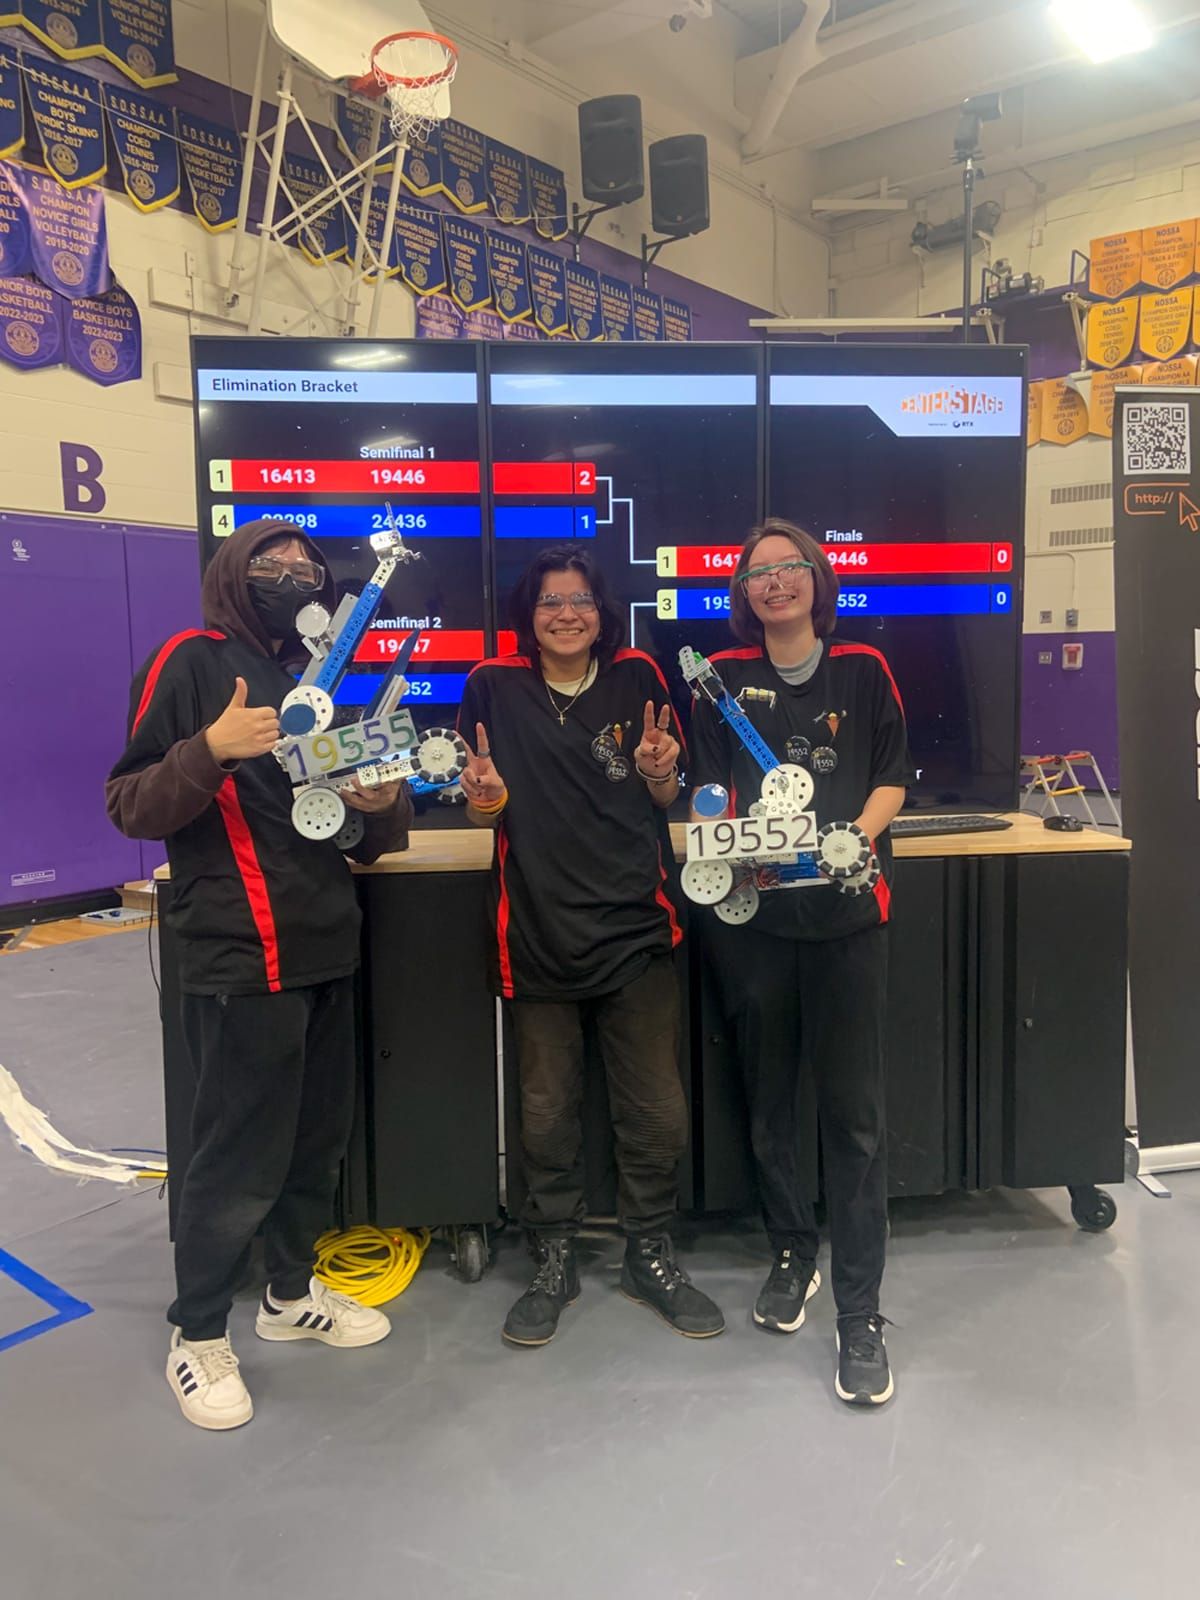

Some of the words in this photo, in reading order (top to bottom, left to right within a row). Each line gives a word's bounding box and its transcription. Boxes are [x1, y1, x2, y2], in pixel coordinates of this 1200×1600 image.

[38, 90, 86, 115] CHAMPION
[50, 106, 76, 123] BOYS
[67, 123, 99, 139] SKIING
[117, 118, 160, 141] CHAMPION
[127, 133, 151, 149] COED
[126, 142, 155, 161] TENNIS
[40, 194, 90, 218] CHAMPION
[32, 205, 69, 225] NOVICE
[71, 216, 99, 233] GIRLS
[35, 219, 98, 246] VOLLEYBALL
[26, 285, 52, 301] BOYS
[1154, 296, 1178, 307] NOSSA
[73, 308, 133, 331] BASKETBALL
[106, 304, 133, 319] BOYS
[212, 378, 297, 393] Elimination
[301, 380, 359, 393] Bracket
[360, 446, 424, 459] Semifinal
[428, 447, 435, 458] 1
[60, 441, 106, 514] B
[217, 470, 224, 482] 1
[260, 469, 316, 484] 16413
[371, 469, 426, 485] 19446
[580, 471, 591, 486] 2
[1135, 491, 1174, 506] http://
[218, 515, 228, 528] 4
[371, 514, 427, 529] 24436
[581, 515, 589, 529] 1
[825, 530, 863, 542] Finals
[663, 556, 670, 568] 1
[703, 553, 741, 567] 1641
[827, 551, 868, 566] 9446
[996, 550, 1007, 564] 0
[662, 598, 672, 612] 3
[703, 595, 731, 610] 195
[837, 593, 868, 608] 552
[996, 592, 1006, 606] 0
[433, 617, 443, 629] 2
[287, 713, 416, 777] 19555
[690, 814, 816, 858] 19552
